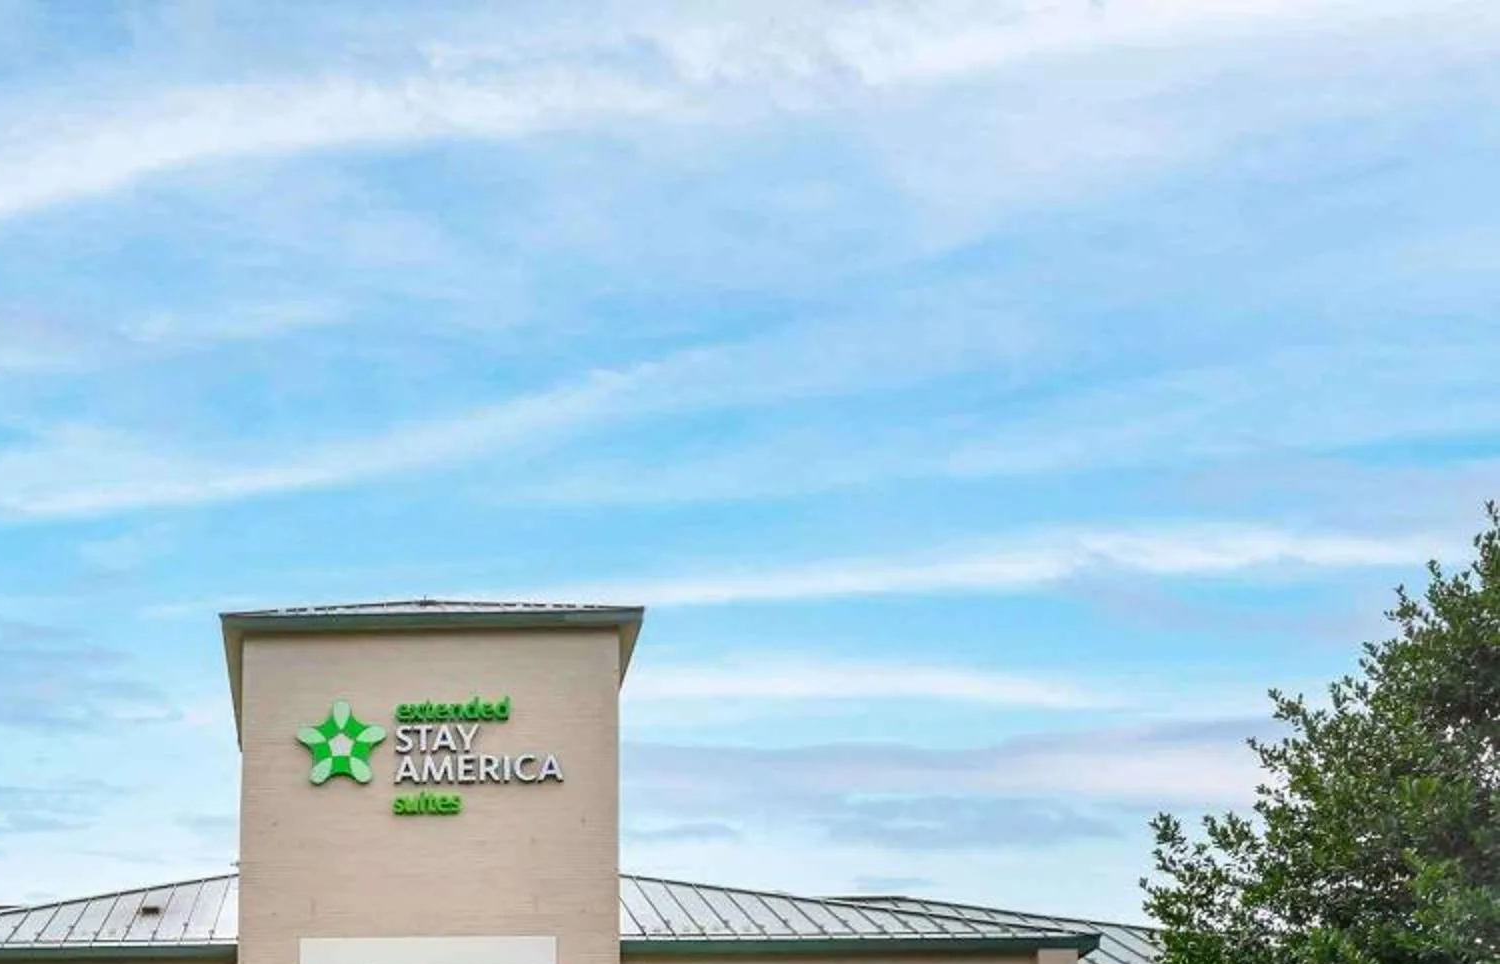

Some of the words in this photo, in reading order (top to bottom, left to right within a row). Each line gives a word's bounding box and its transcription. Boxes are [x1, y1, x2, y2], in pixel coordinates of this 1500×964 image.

[394, 697, 511, 722] extended
[395, 724, 479, 753] STAY
[395, 753, 563, 783] AMERICA
[393, 792, 463, 815] suites
